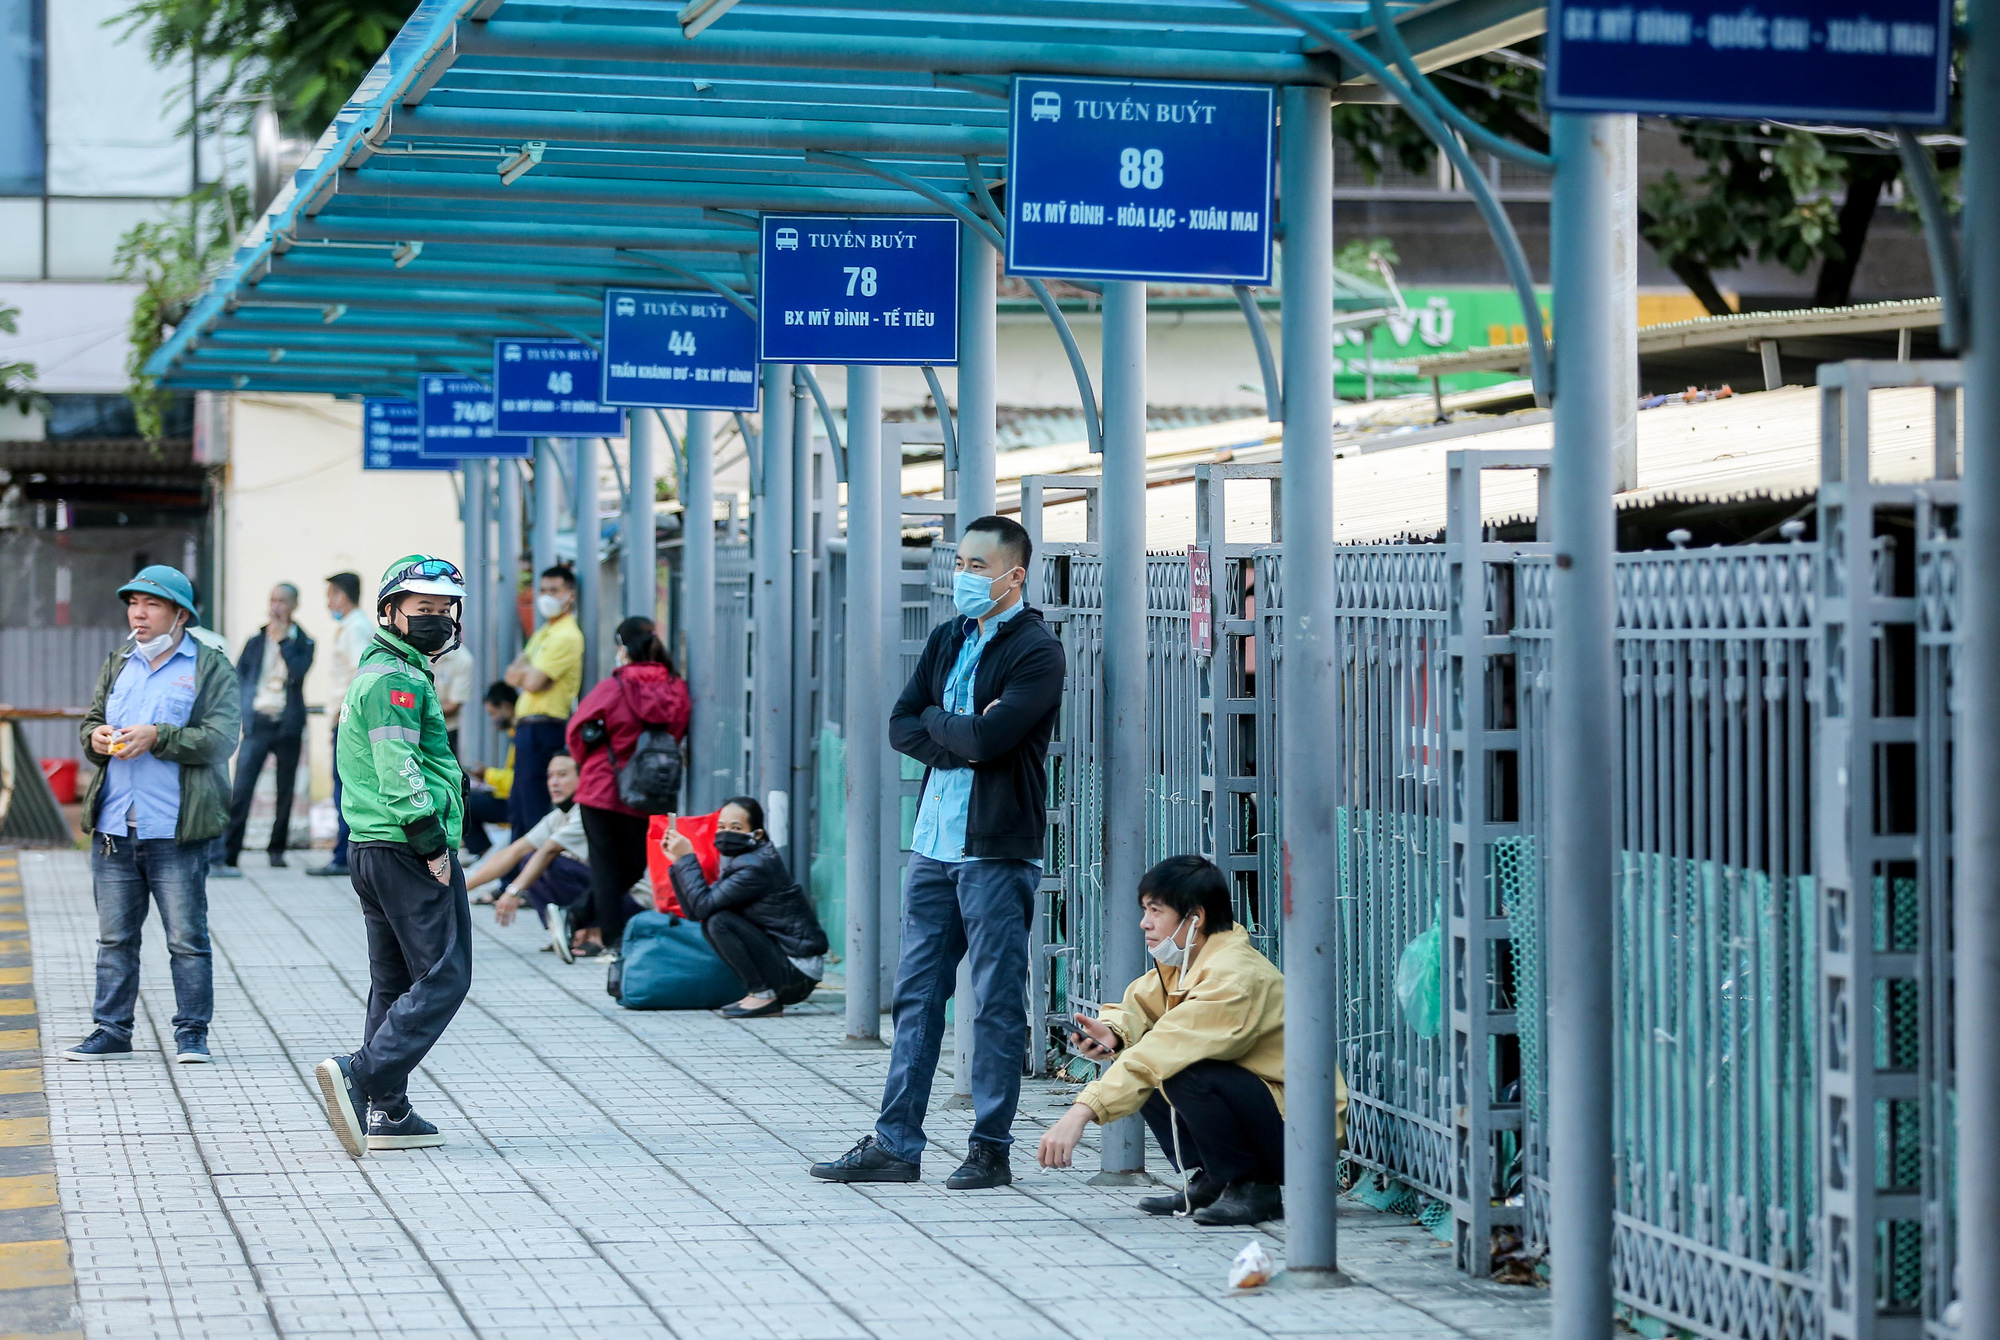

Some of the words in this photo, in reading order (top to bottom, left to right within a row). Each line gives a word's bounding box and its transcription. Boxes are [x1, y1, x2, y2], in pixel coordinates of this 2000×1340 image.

[1074, 97, 1150, 122] TUYẾN
[1156, 100, 1216, 124] BUÝT
[1119, 147, 1164, 190] 88
[1022, 202, 1041, 223] BX
[1045, 201, 1067, 224] MỸ
[1070, 201, 1104, 225] ĐÌNH
[1117, 202, 1146, 227] HÒA
[1149, 208, 1175, 232] LẠC
[1188, 207, 1227, 231] XUÂN
[1231, 212, 1258, 232] MAI
[808, 231, 866, 249] TUYẾN
[871, 231, 917, 249] BUÝT
[843, 266, 877, 297] 78
[785, 311, 804, 326] BX
[808, 309, 831, 326] MỸ
[834, 308, 869, 326] ĐÌNH
[883, 307, 901, 327] TẾ
[904, 309, 935, 327] TIÊU
[667, 330, 696, 357] 44
[547, 370, 573, 395] 46
[638, 363, 672, 380] KHÁNH
[695, 368, 709, 382] BX
